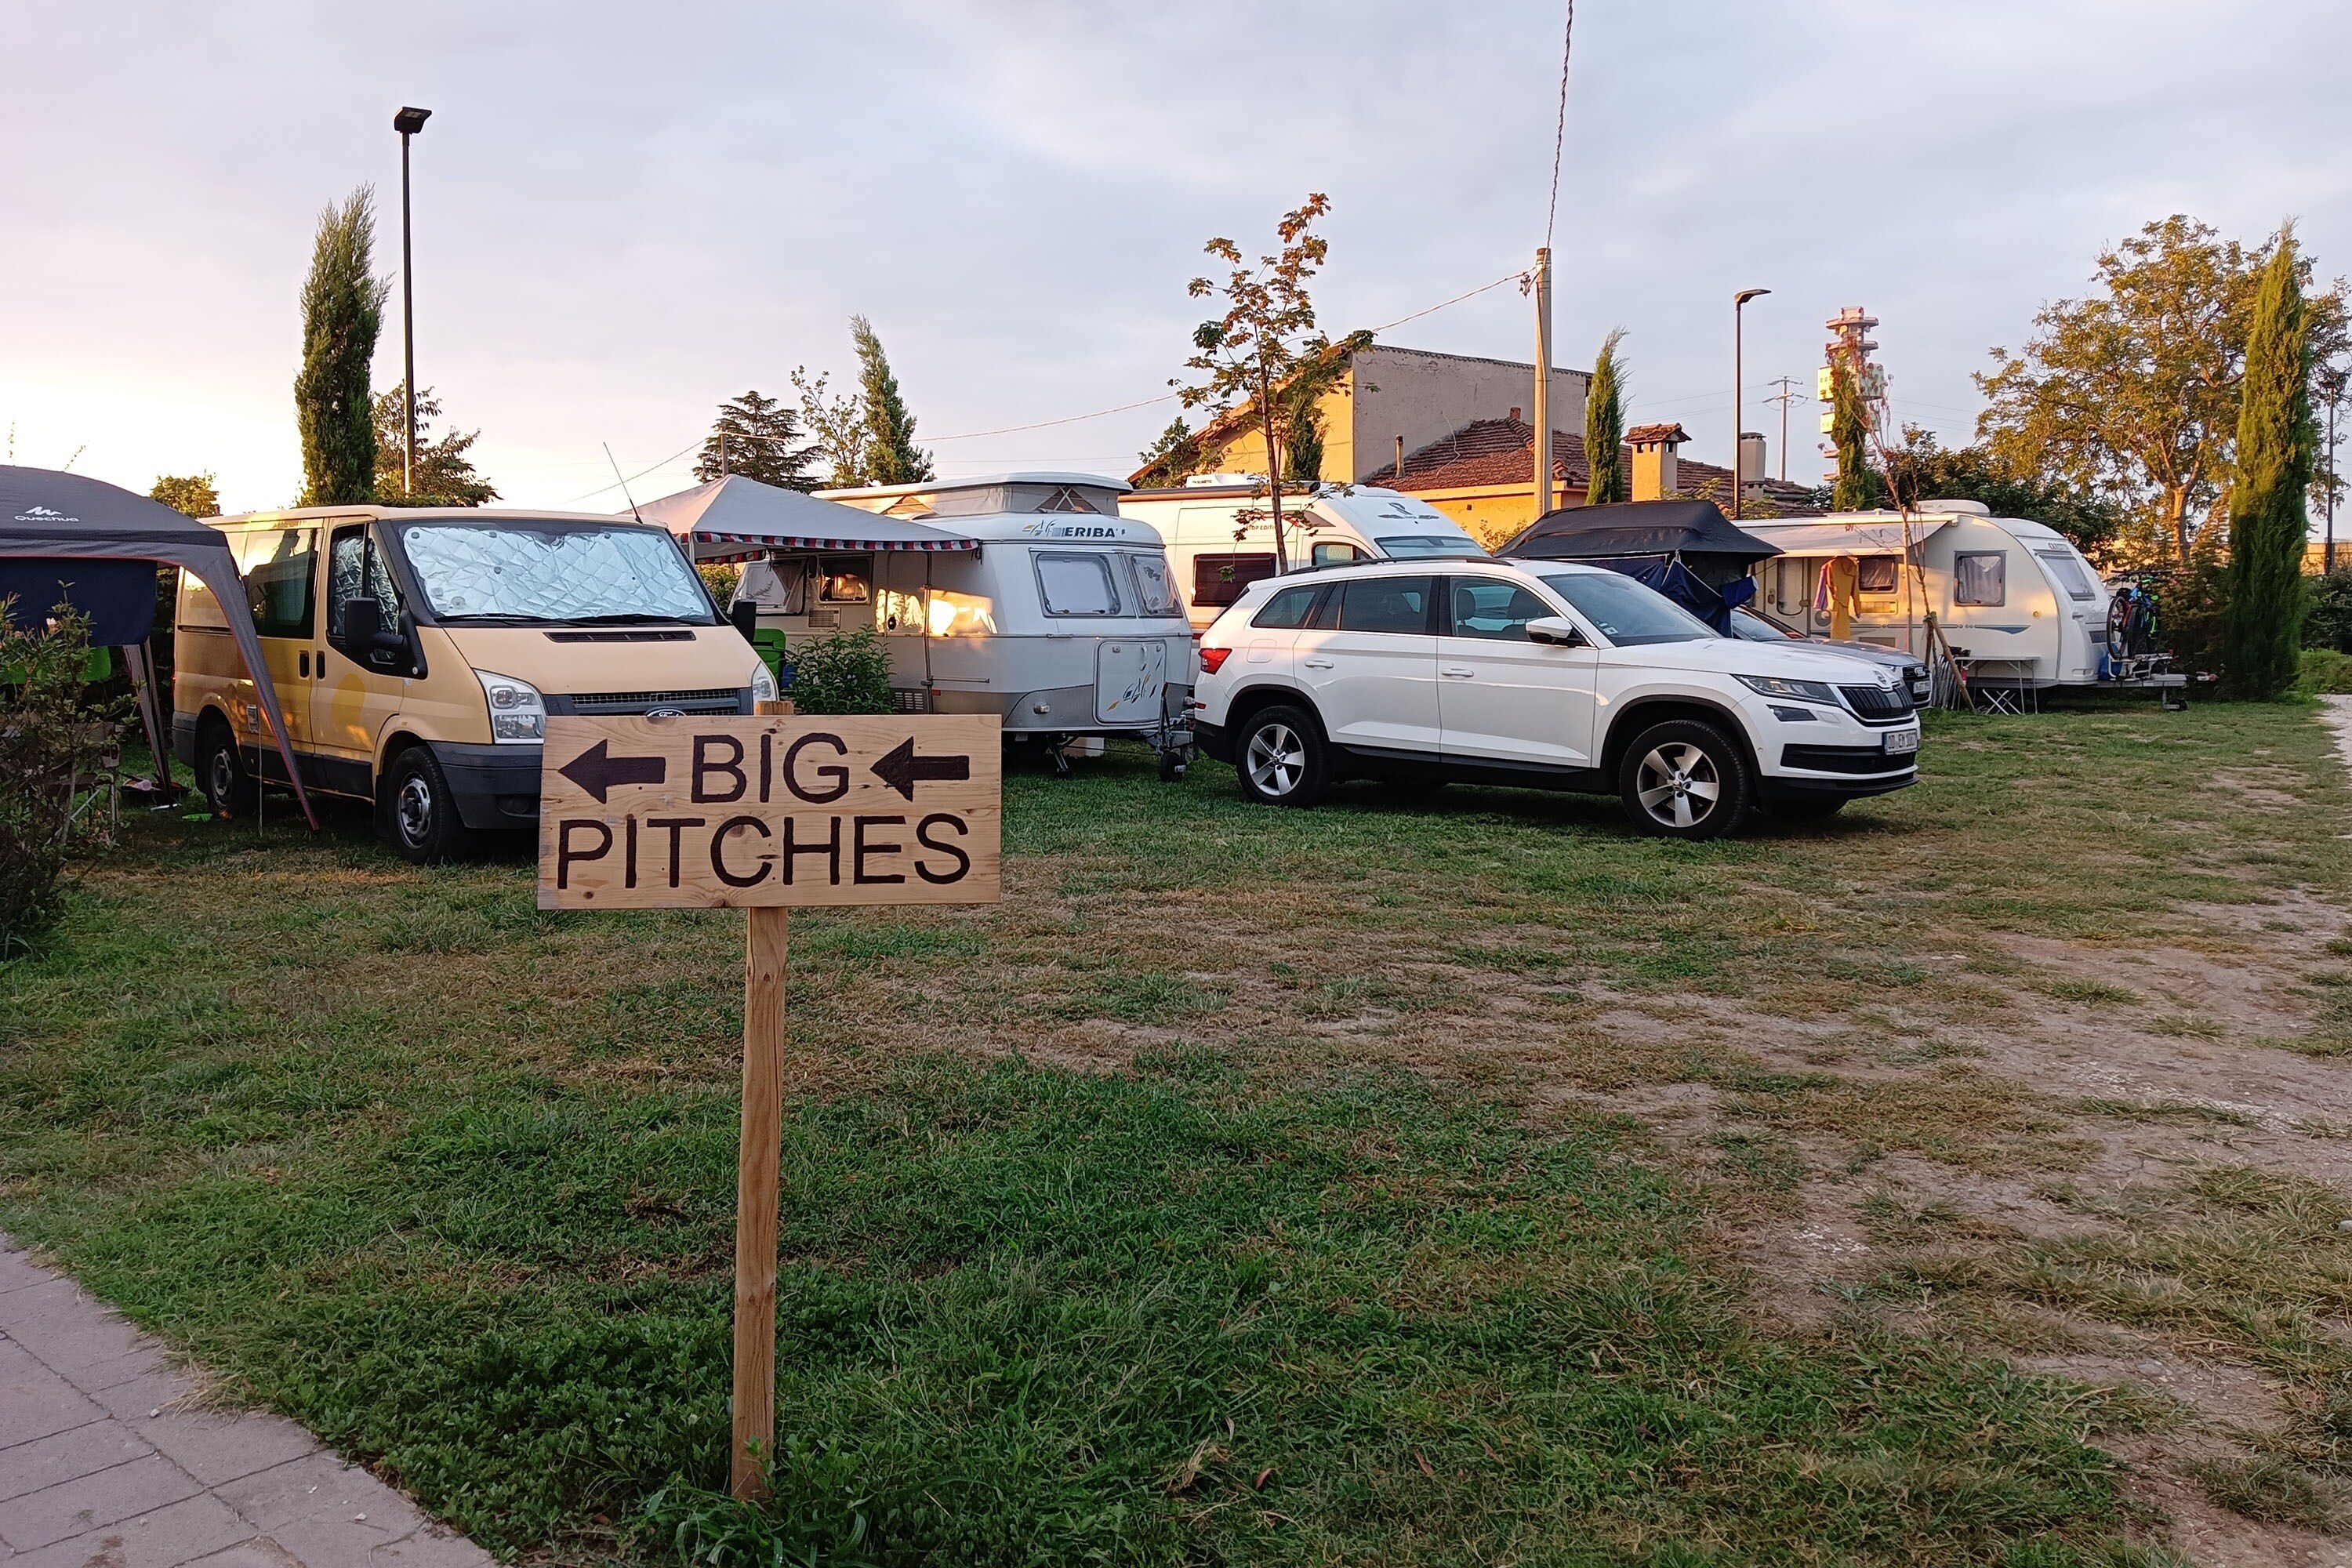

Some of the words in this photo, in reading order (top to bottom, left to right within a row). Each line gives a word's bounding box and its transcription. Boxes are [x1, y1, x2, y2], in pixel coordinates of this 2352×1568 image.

[1065, 527, 1116, 538] ERIBA
[691, 732, 850, 804] BIG
[557, 813, 972, 889] PITCHES
